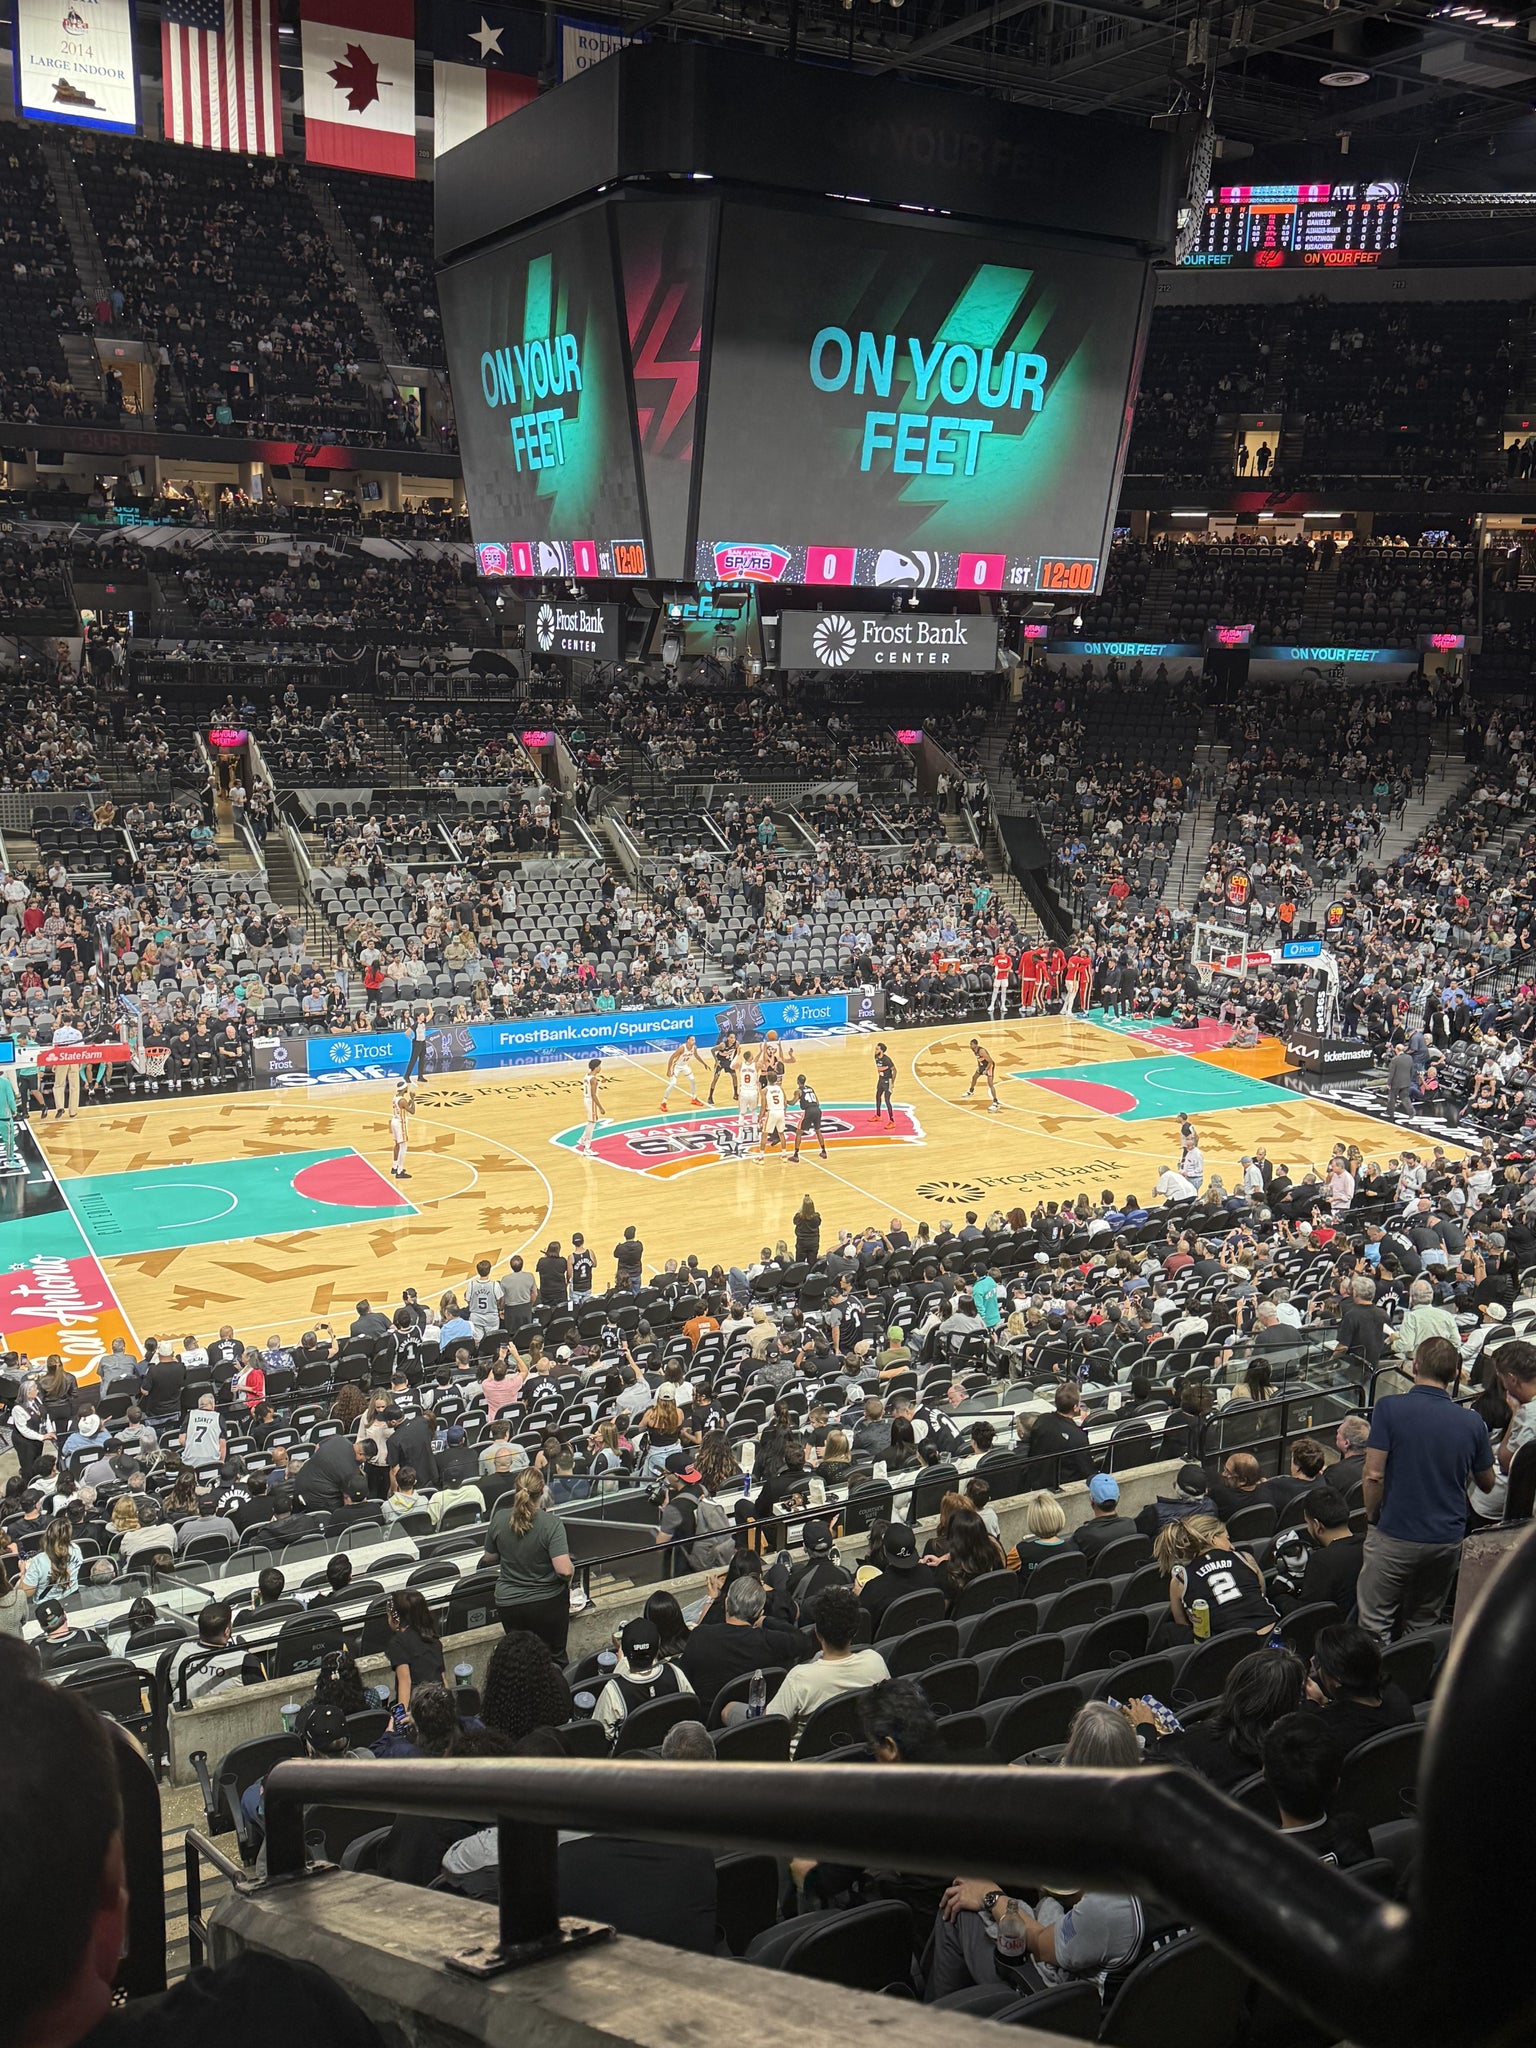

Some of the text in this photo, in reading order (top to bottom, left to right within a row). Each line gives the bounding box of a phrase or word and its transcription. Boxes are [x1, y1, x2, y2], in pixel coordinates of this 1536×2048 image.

[61, 41, 93, 58] 2014
[30, 55, 126, 80] LARGE INDOOR
[1331, 186, 1357, 201] ATL
[1182, 254, 1233, 265] OUR FEET
[1304, 252, 1381, 264] ON YOUR FEET
[480, 333, 582, 408] ON YOUR
[809, 326, 1048, 411] ON YOUR
[510, 407, 565, 472] FEET
[860, 411, 994, 475] FEET
[255, 534, 269, 545] 107
[518, 545, 644, 574] 0 0 1ST 12:00
[724, 556, 772, 571] SPURS
[823, 553, 1093, 590] 0 0 1ST 12:00
[556, 607, 604, 634] Frost Bank
[861, 618, 968, 645] Frost Bank
[561, 638, 596, 653] CENTER
[1084, 642, 1168, 657] ON YOUR FEET
[874, 652, 951, 664] CENTER
[1290, 647, 1380, 662] ON YOUR FEET
[1330, 914, 1341, 924] 24
[1299, 944, 1315, 954] Frost
[801, 1005, 831, 1020] Frost
[858, 1009, 875, 1018] Frost
[1316, 990, 1326, 1033] bet365
[500, 1014, 694, 1045] FrostBank.com/SpursCard
[794, 1020, 895, 1038] Self.
[354, 1042, 393, 1059] Frost
[463, 1043, 475, 1053] VISA
[1323, 1049, 1373, 1063] ticketmaster
[269, 1060, 293, 1071] Frost
[276, 1064, 401, 1087] Self.
[744, 1073, 752, 1084] 8
[473, 1083, 546, 1096] Frost
[507, 1086, 608, 1100] CENTR
[772, 1094, 780, 1105] 5
[623, 1126, 686, 1139] SAN
[972, 1159, 1130, 1188] Frost Bank
[1018, 1174, 1124, 1193] CENTER
[579, 1262, 586, 1278] 1
[10, 1254, 103, 1327] Antonio
[478, 1297, 488, 1310] 5
[222, 1349, 234, 1361] 5
[406, 1344, 416, 1361] 1
[194, 1426, 208, 1442] 7
[1196, 1560, 1232, 1578] LEONARD
[1207, 1571, 1243, 1605] 2
[312, 1643, 326, 1651] BOX
[633, 1643, 650, 1651] SPURS
